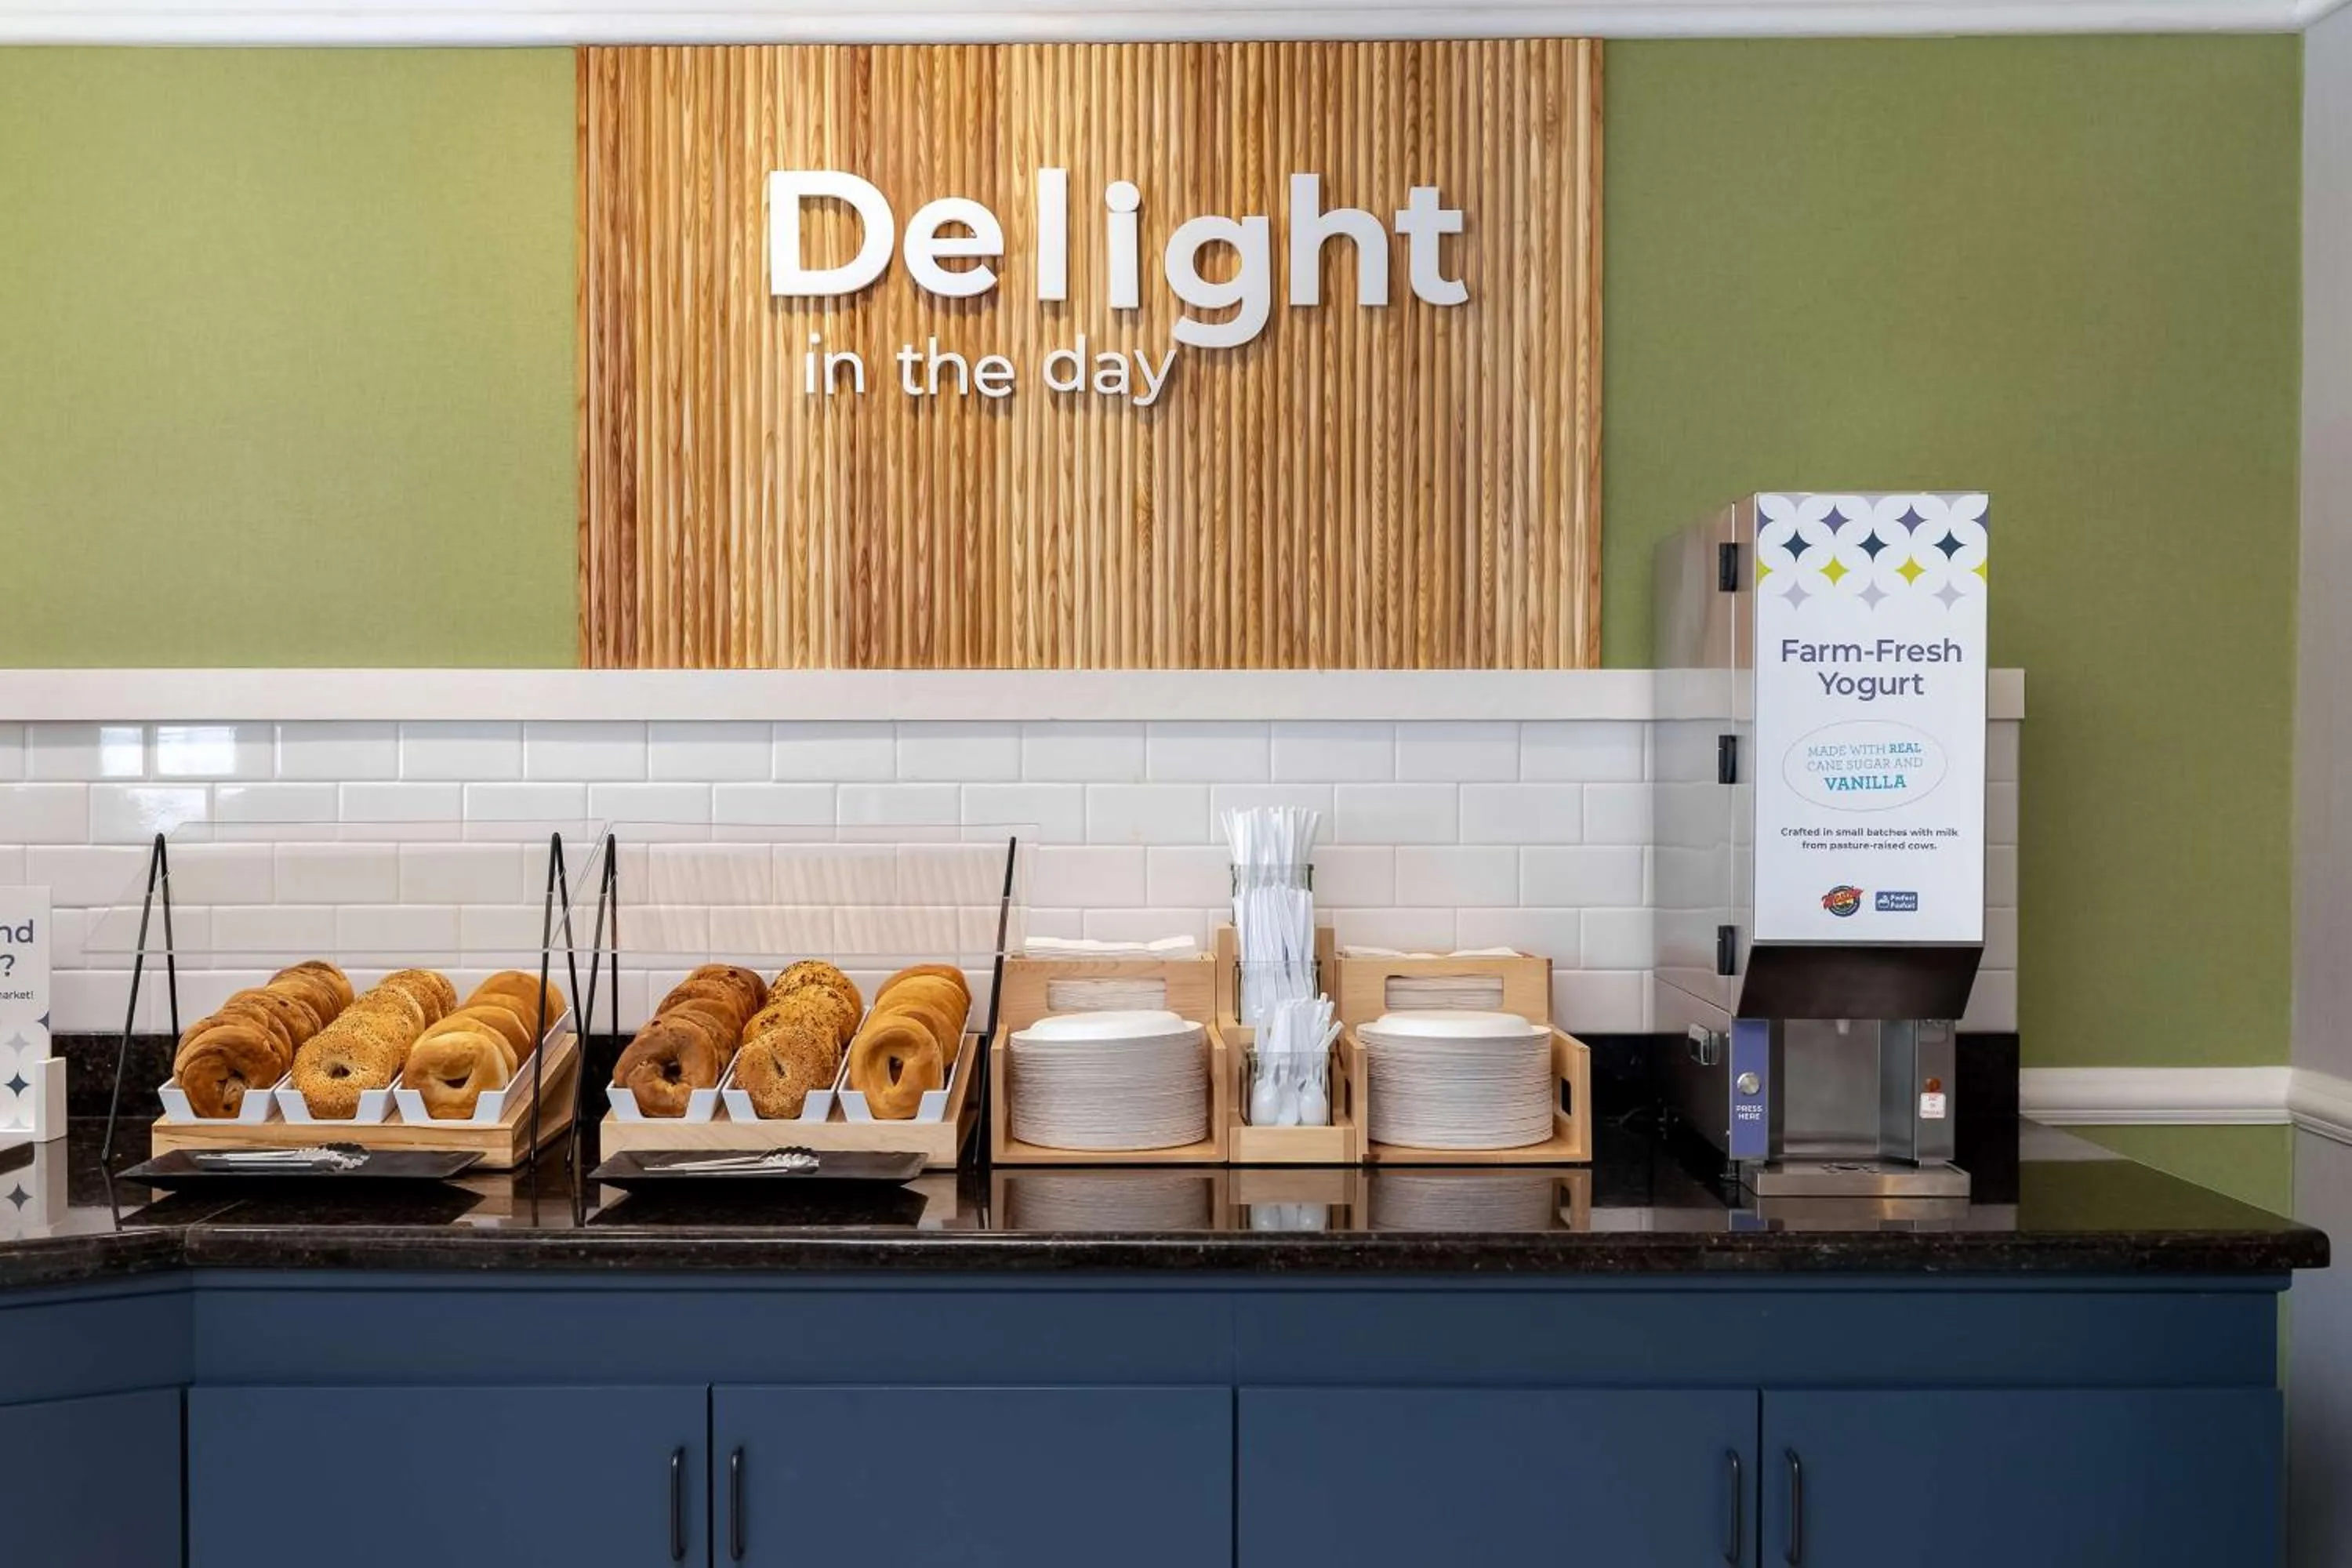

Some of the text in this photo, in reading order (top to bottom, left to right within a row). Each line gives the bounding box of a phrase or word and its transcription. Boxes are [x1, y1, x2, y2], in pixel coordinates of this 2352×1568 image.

[770, 167, 1468, 349] Delight
[805, 333, 1176, 407] in the day
[1781, 637, 1963, 663] Farm-Fresh
[1818, 672, 1925, 701] Yogurt
[1807, 742, 1922, 757] MADE WITH REAL
[1806, 756, 1923, 771] CANE SUGAR AND
[1824, 775, 1907, 791] VANILLA
[1780, 827, 1958, 837] Crafted in small batches with milk
[1802, 840, 1937, 851] from pasture-raised cows.
[0, 990, 34, 1000] arket!
